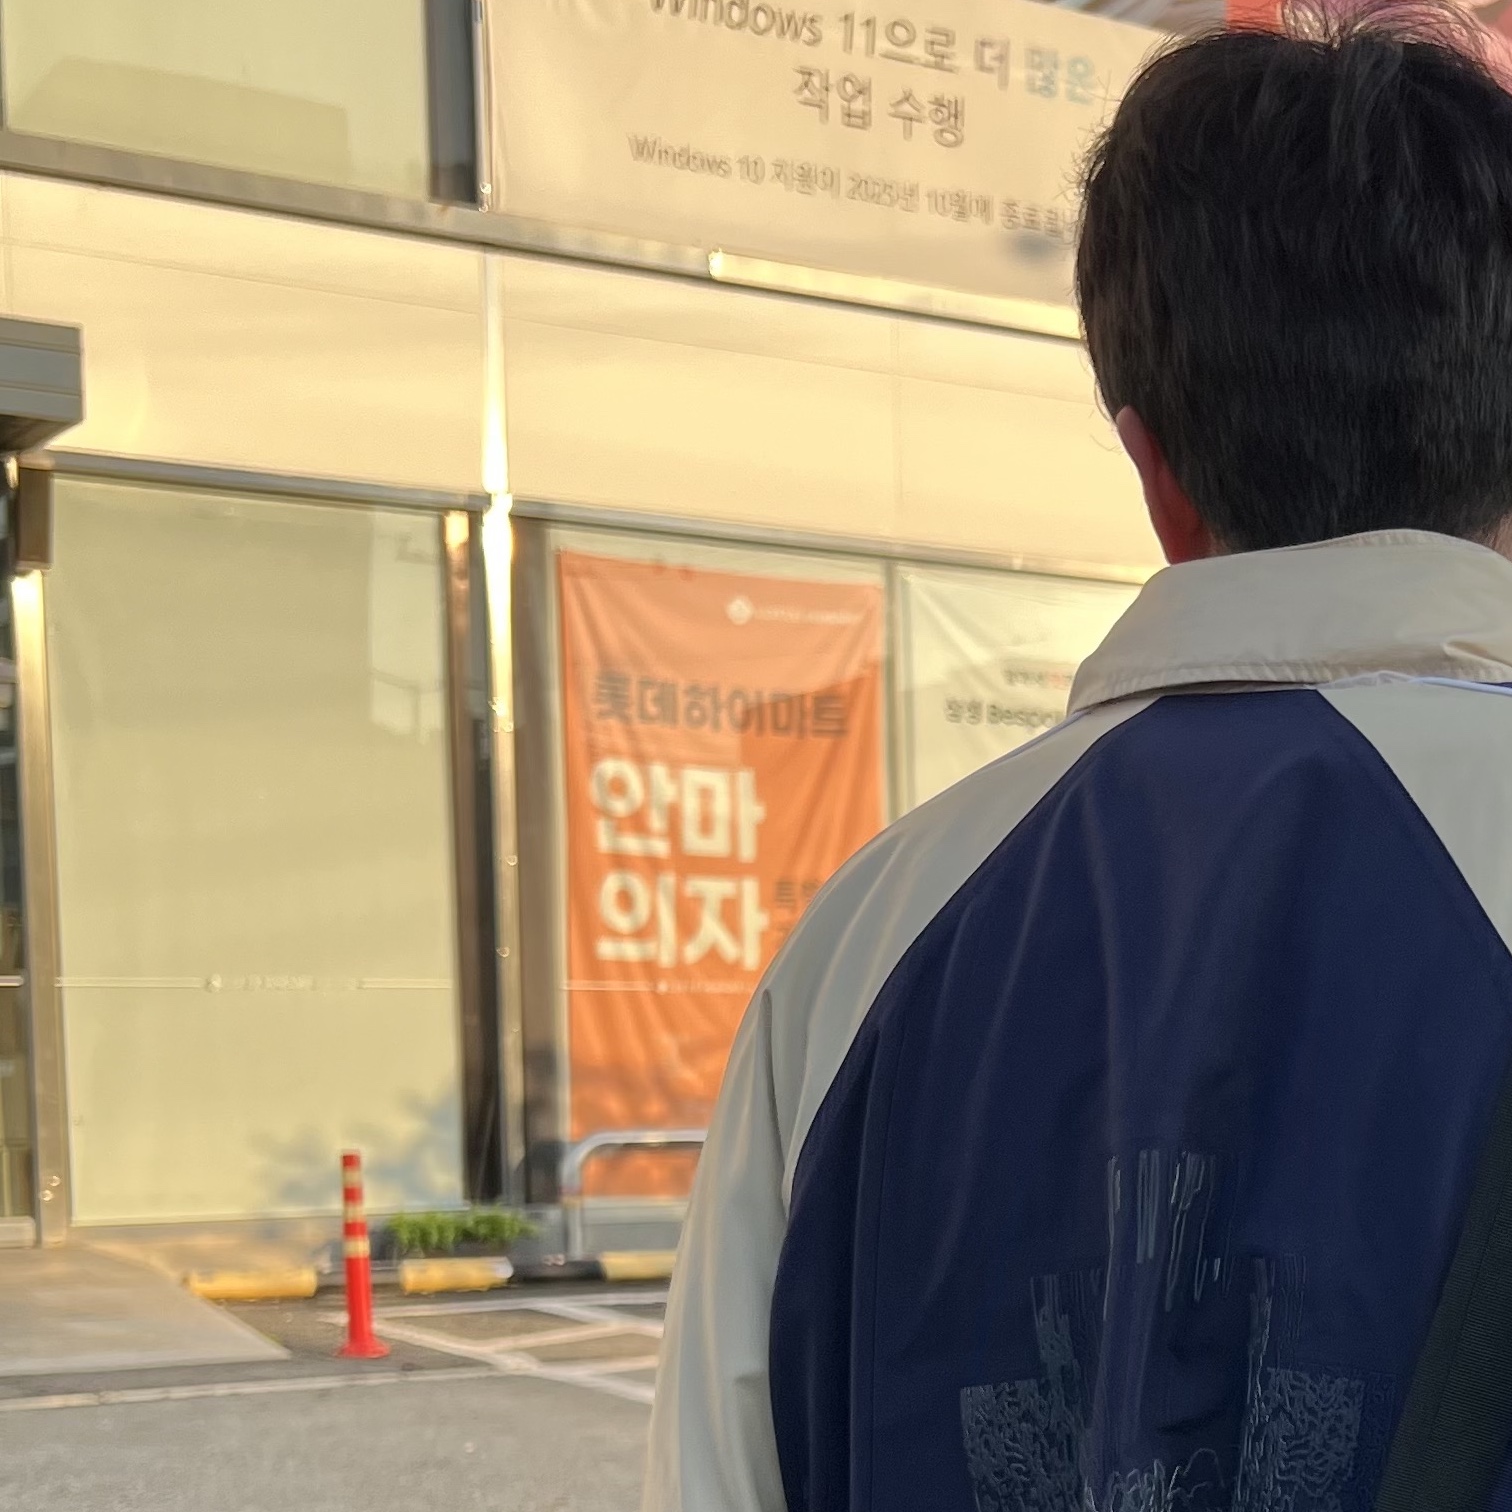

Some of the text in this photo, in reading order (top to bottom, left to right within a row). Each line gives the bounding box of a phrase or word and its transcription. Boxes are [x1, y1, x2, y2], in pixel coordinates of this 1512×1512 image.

[839, 11, 960, 74] 11으로
[974, 36, 1010, 91] 더
[792, 66, 966, 148] 작업 수행
[627, 132, 732, 179] Windows
[736, 154, 766, 185] 10
[596, 670, 847, 740] 롯데하이마트
[590, 757, 766, 864] 안마
[596, 869, 769, 971] 의자
